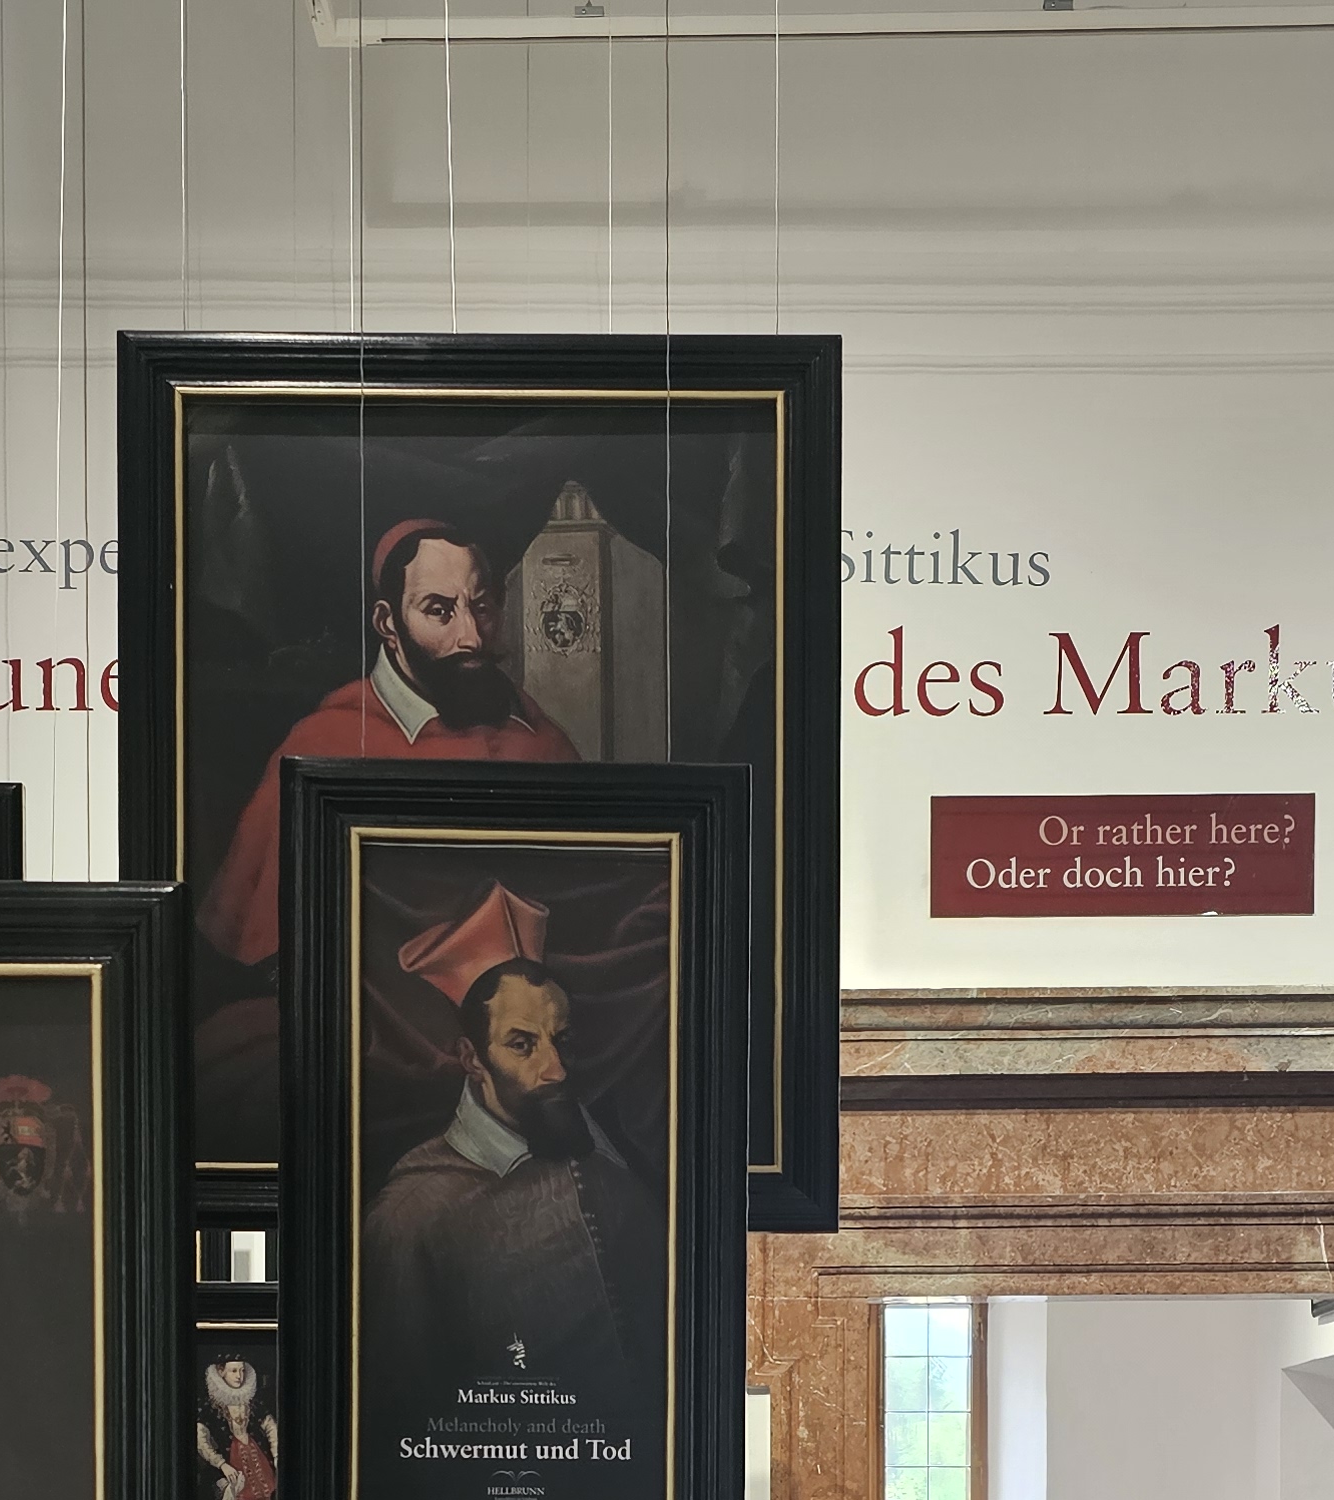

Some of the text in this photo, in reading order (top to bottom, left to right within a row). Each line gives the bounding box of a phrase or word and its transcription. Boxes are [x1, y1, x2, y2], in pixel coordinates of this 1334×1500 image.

[854, 625, 1005, 718] des
[1039, 813, 1296, 846] Or rather here?
[966, 856, 1236, 889] Oder doch hier?
[457, 1389, 577, 1405] Markus Sittikus
[427, 1417, 605, 1436] Melancholy and death
[399, 1437, 631, 1460] Schwermut und Tod
[487, 1486, 545, 1496] HELLBRUNN
